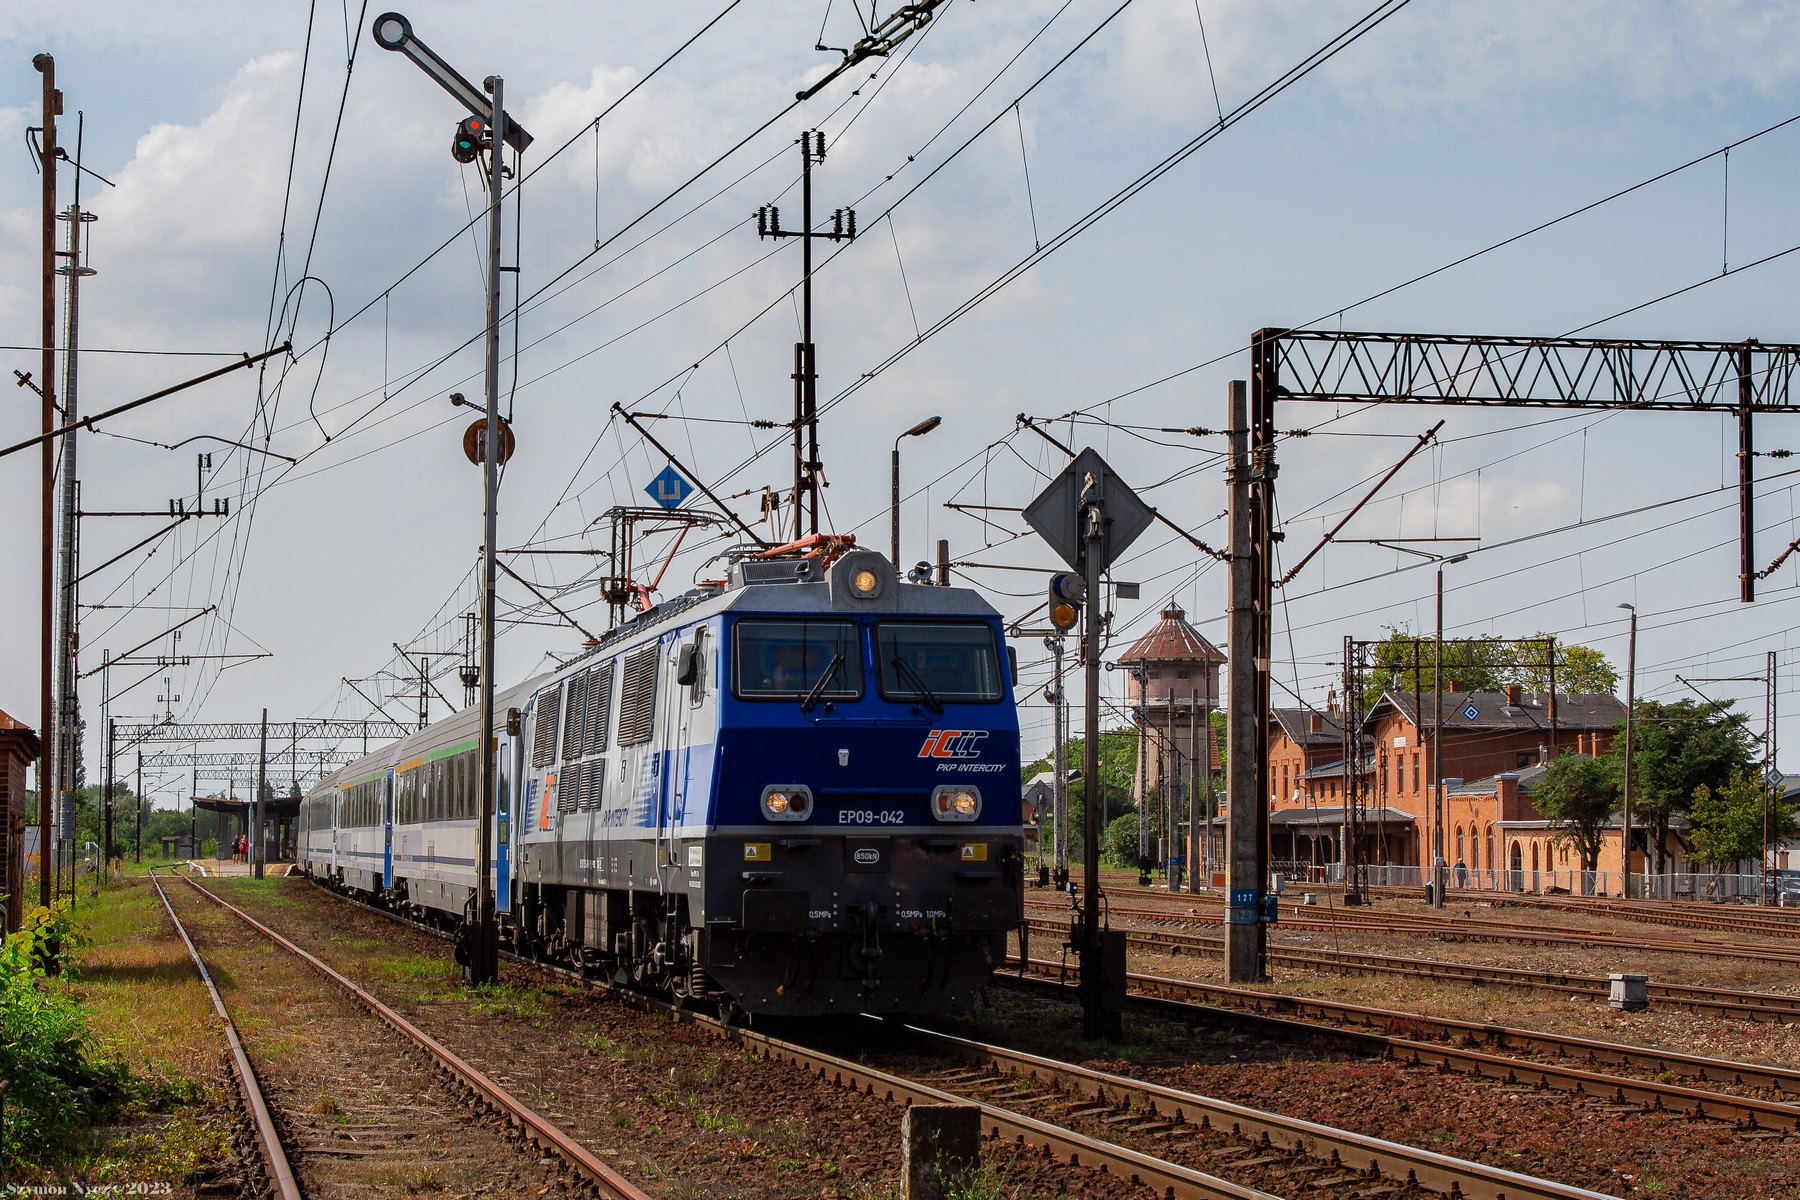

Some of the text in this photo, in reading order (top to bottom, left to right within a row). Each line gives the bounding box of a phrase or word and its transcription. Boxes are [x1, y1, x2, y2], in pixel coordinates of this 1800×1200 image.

[936, 763, 1006, 773] PKP INTERCITY
[838, 810, 904, 824] EP09-042
[856, 852, 878, 860] 850kN
